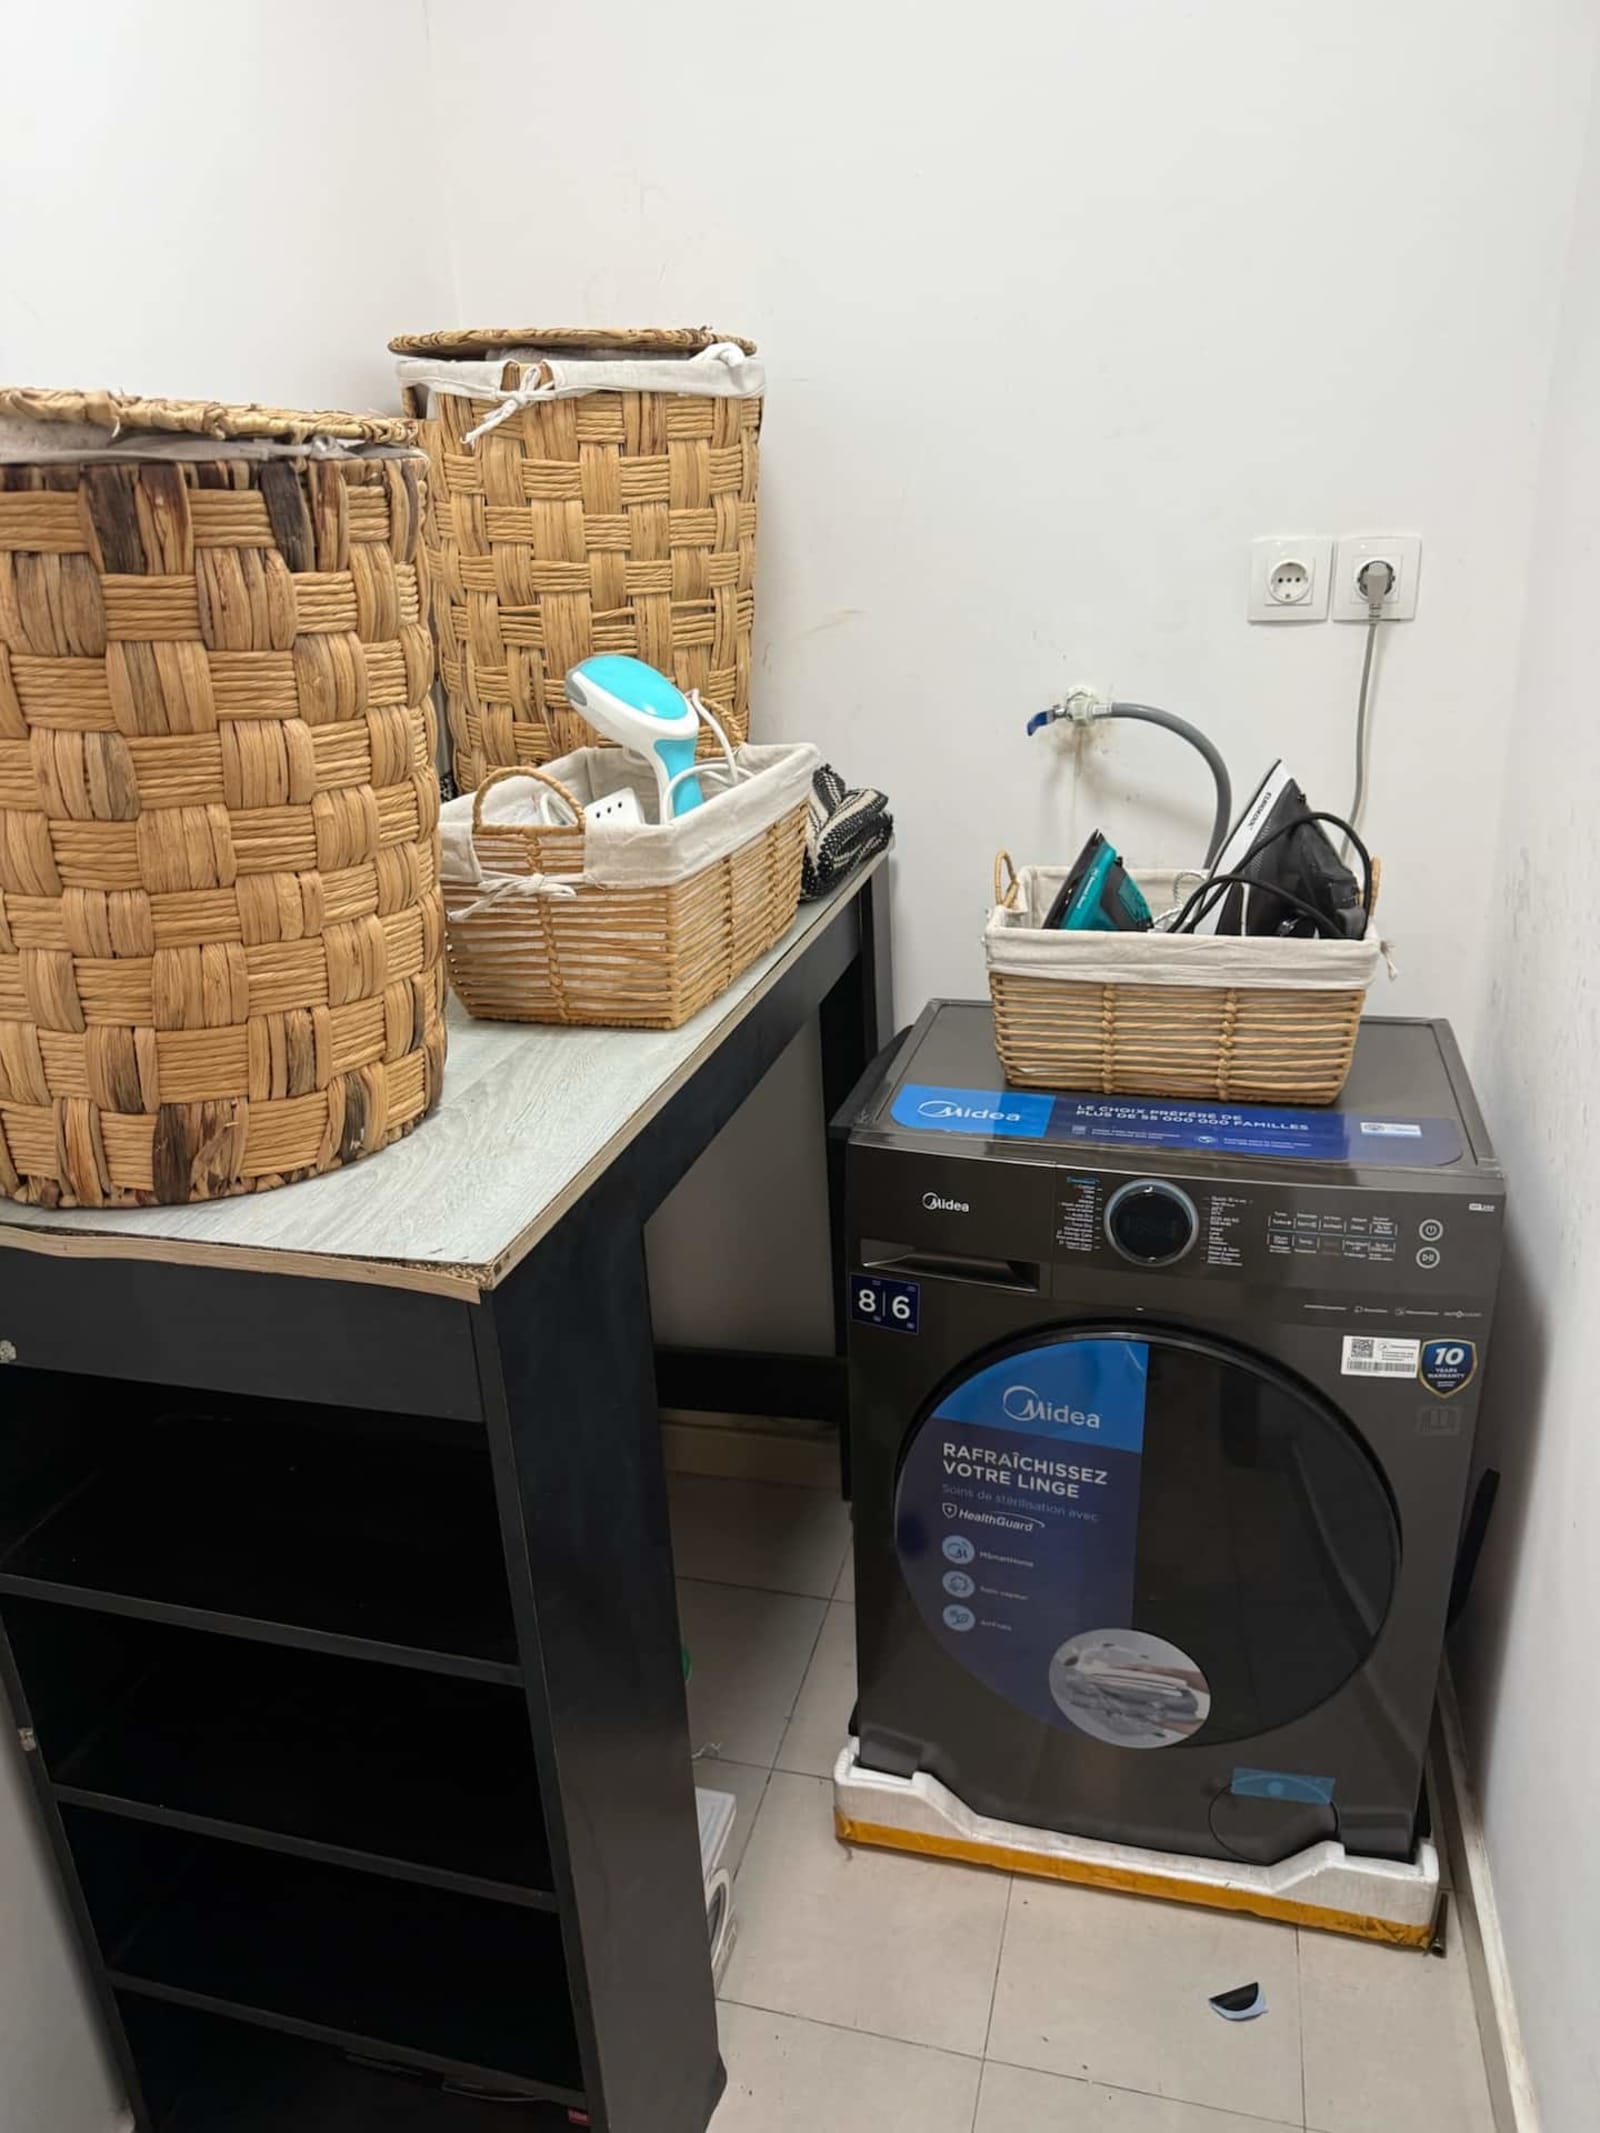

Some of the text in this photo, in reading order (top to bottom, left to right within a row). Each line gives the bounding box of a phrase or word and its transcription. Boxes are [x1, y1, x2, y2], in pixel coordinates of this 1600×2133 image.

[917, 1099, 1022, 1122] Midea
[1076, 1110, 1112, 1118] PLUS
[1162, 1115, 1194, 1124] 000
[1198, 1118, 1229, 1126] 000
[1233, 1120, 1309, 1131] FAMILLES
[1078, 1104, 1095, 1112] LE
[1099, 1106, 1145, 1115] CHOIX
[922, 1192, 970, 1213] Midea
[858, 1288, 911, 1320] 8 6
[1434, 1347, 1465, 1366] 10
[1002, 1385, 1102, 1429] Midea
[942, 1441, 1108, 1486] RAFRAÎCHISSEZ
[942, 1460, 1080, 1499] VOTRE LINGE
[942, 1484, 974, 1499] Soins
[977, 1490, 992, 1502] de
[1068, 1508, 1099, 1524] avec
[958, 1508, 1034, 1533] HealthGuard
